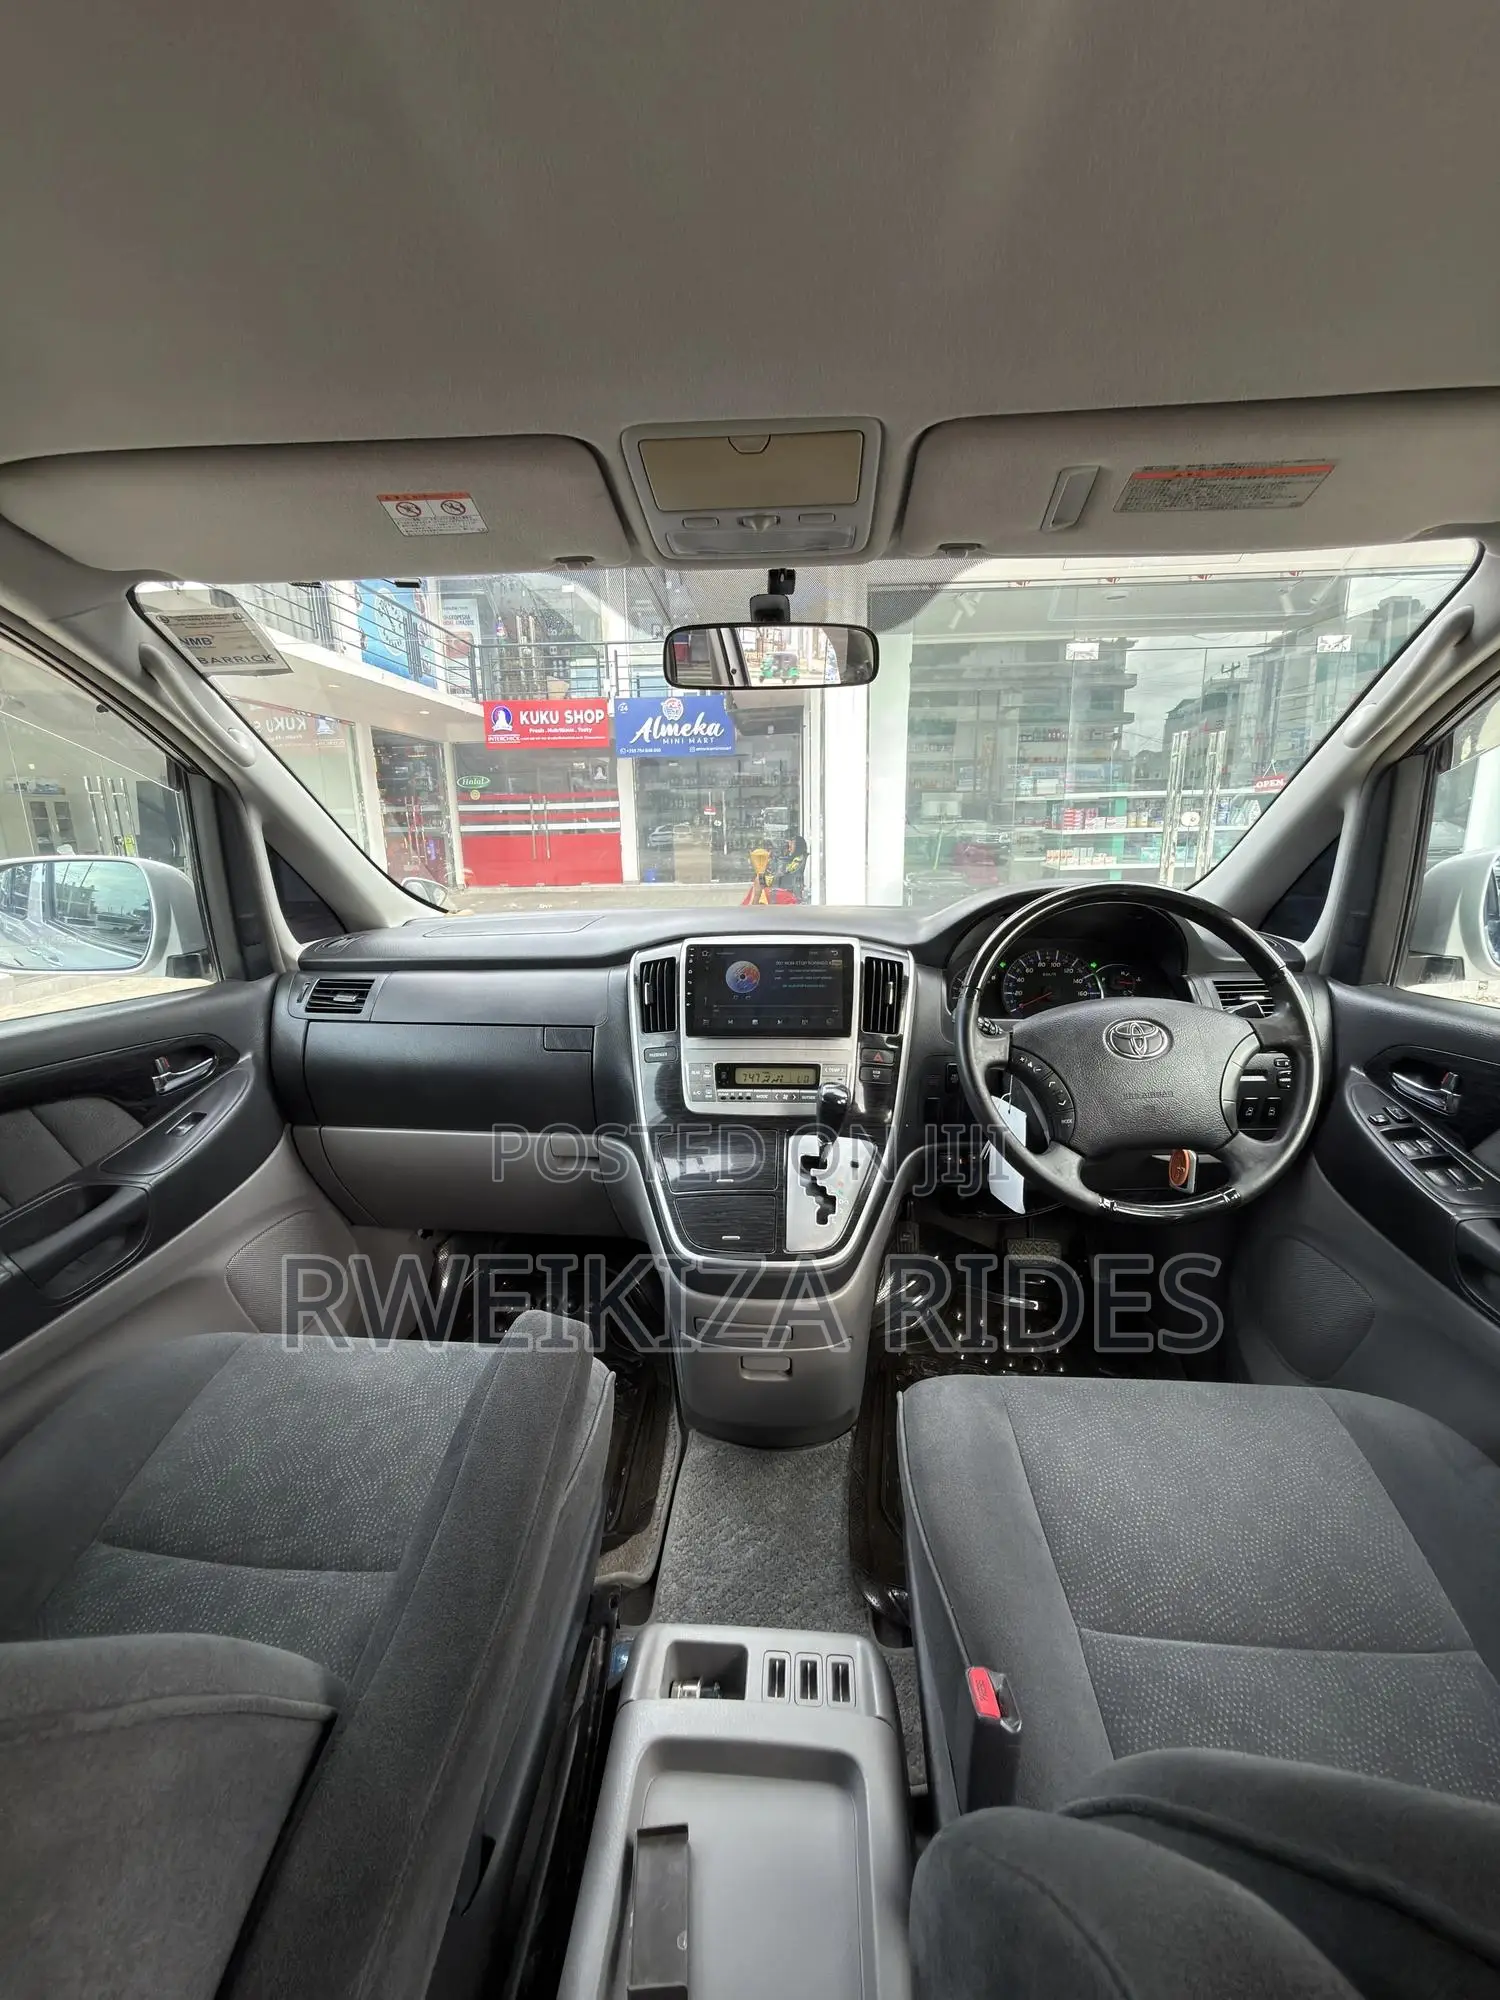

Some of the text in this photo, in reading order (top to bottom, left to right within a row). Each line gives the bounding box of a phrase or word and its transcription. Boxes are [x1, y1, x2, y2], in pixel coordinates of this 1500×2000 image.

[198, 654, 276, 664] BARRICK
[519, 709, 605, 725] KUKU SHOP
[630, 712, 724, 744] Almeka
[1255, 779, 1284, 788] OPEN
